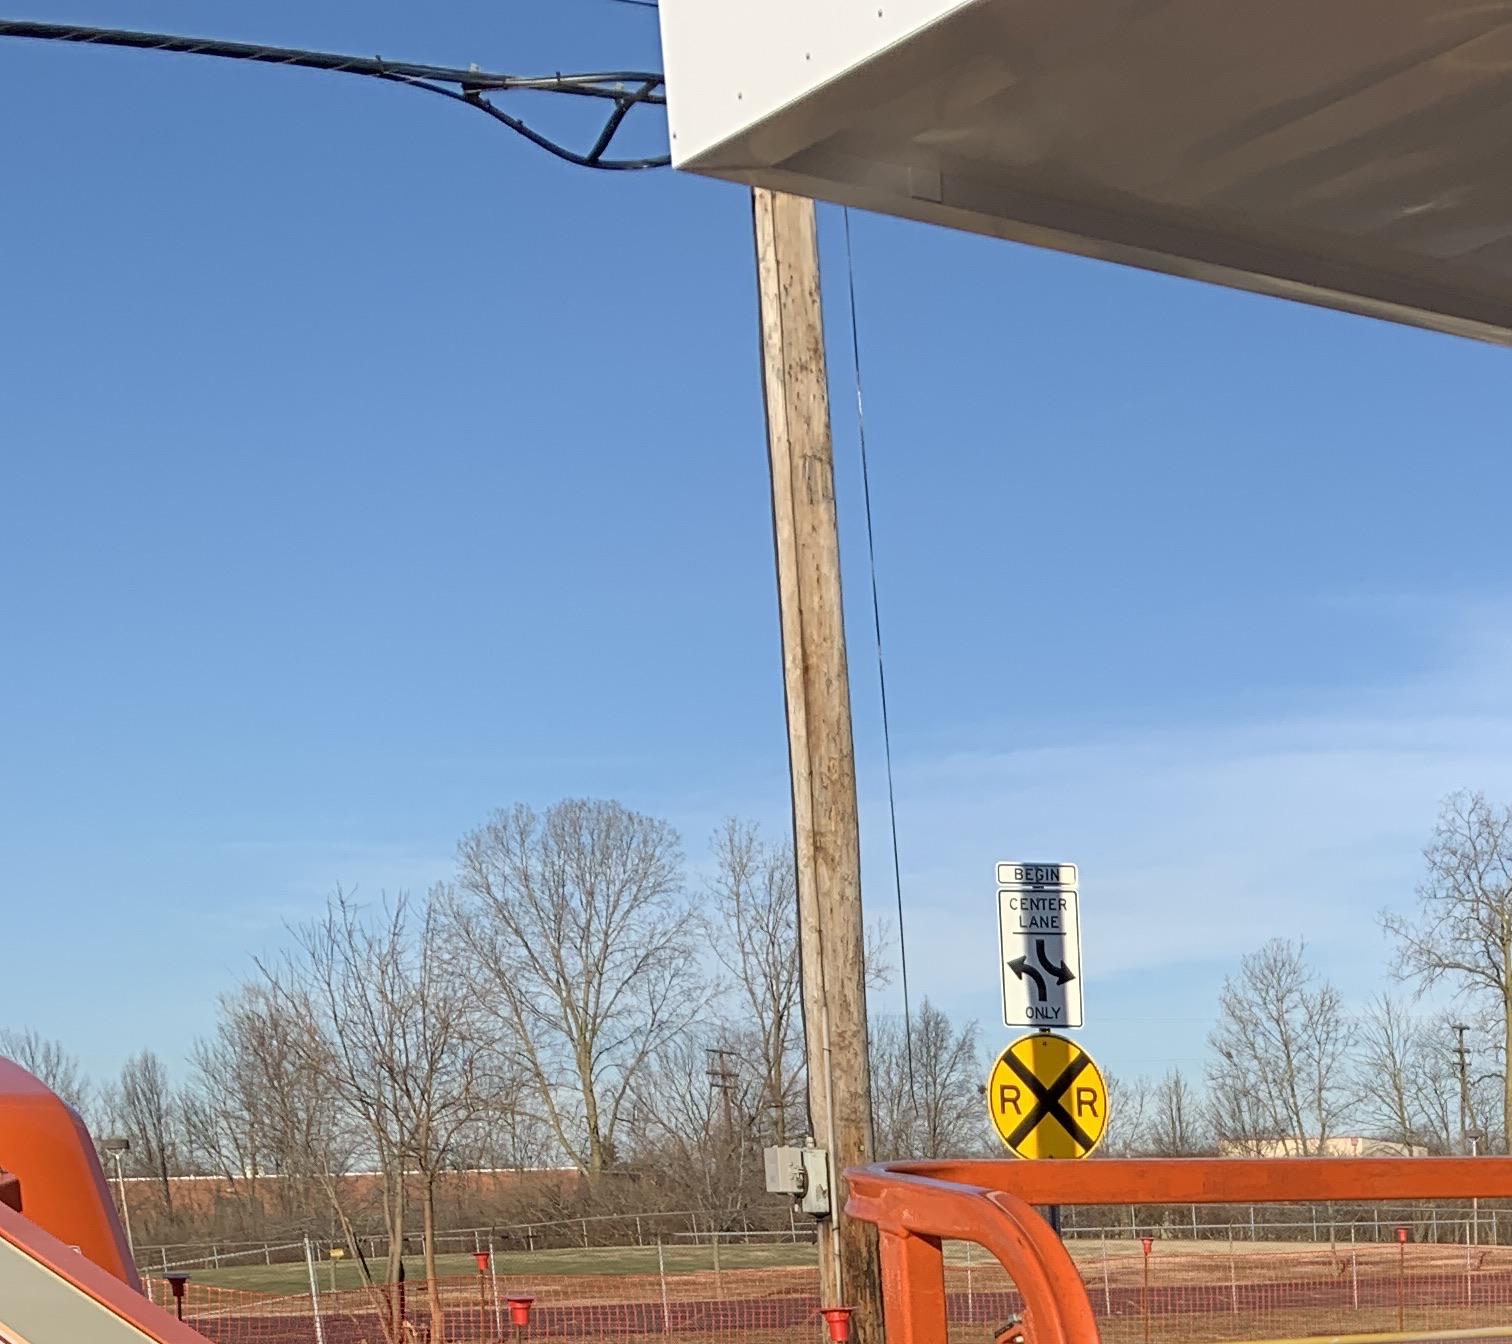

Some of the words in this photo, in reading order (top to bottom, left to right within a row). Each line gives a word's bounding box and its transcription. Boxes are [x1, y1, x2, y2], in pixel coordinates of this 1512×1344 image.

[1014, 867, 1060, 882] BEGIN
[1009, 898, 1067, 911] CENTER
[1019, 915, 1059, 929] LANE
[1025, 1006, 1062, 1020] ONLY
[999, 1084, 1022, 1116] R
[1076, 1087, 1099, 1119] R
